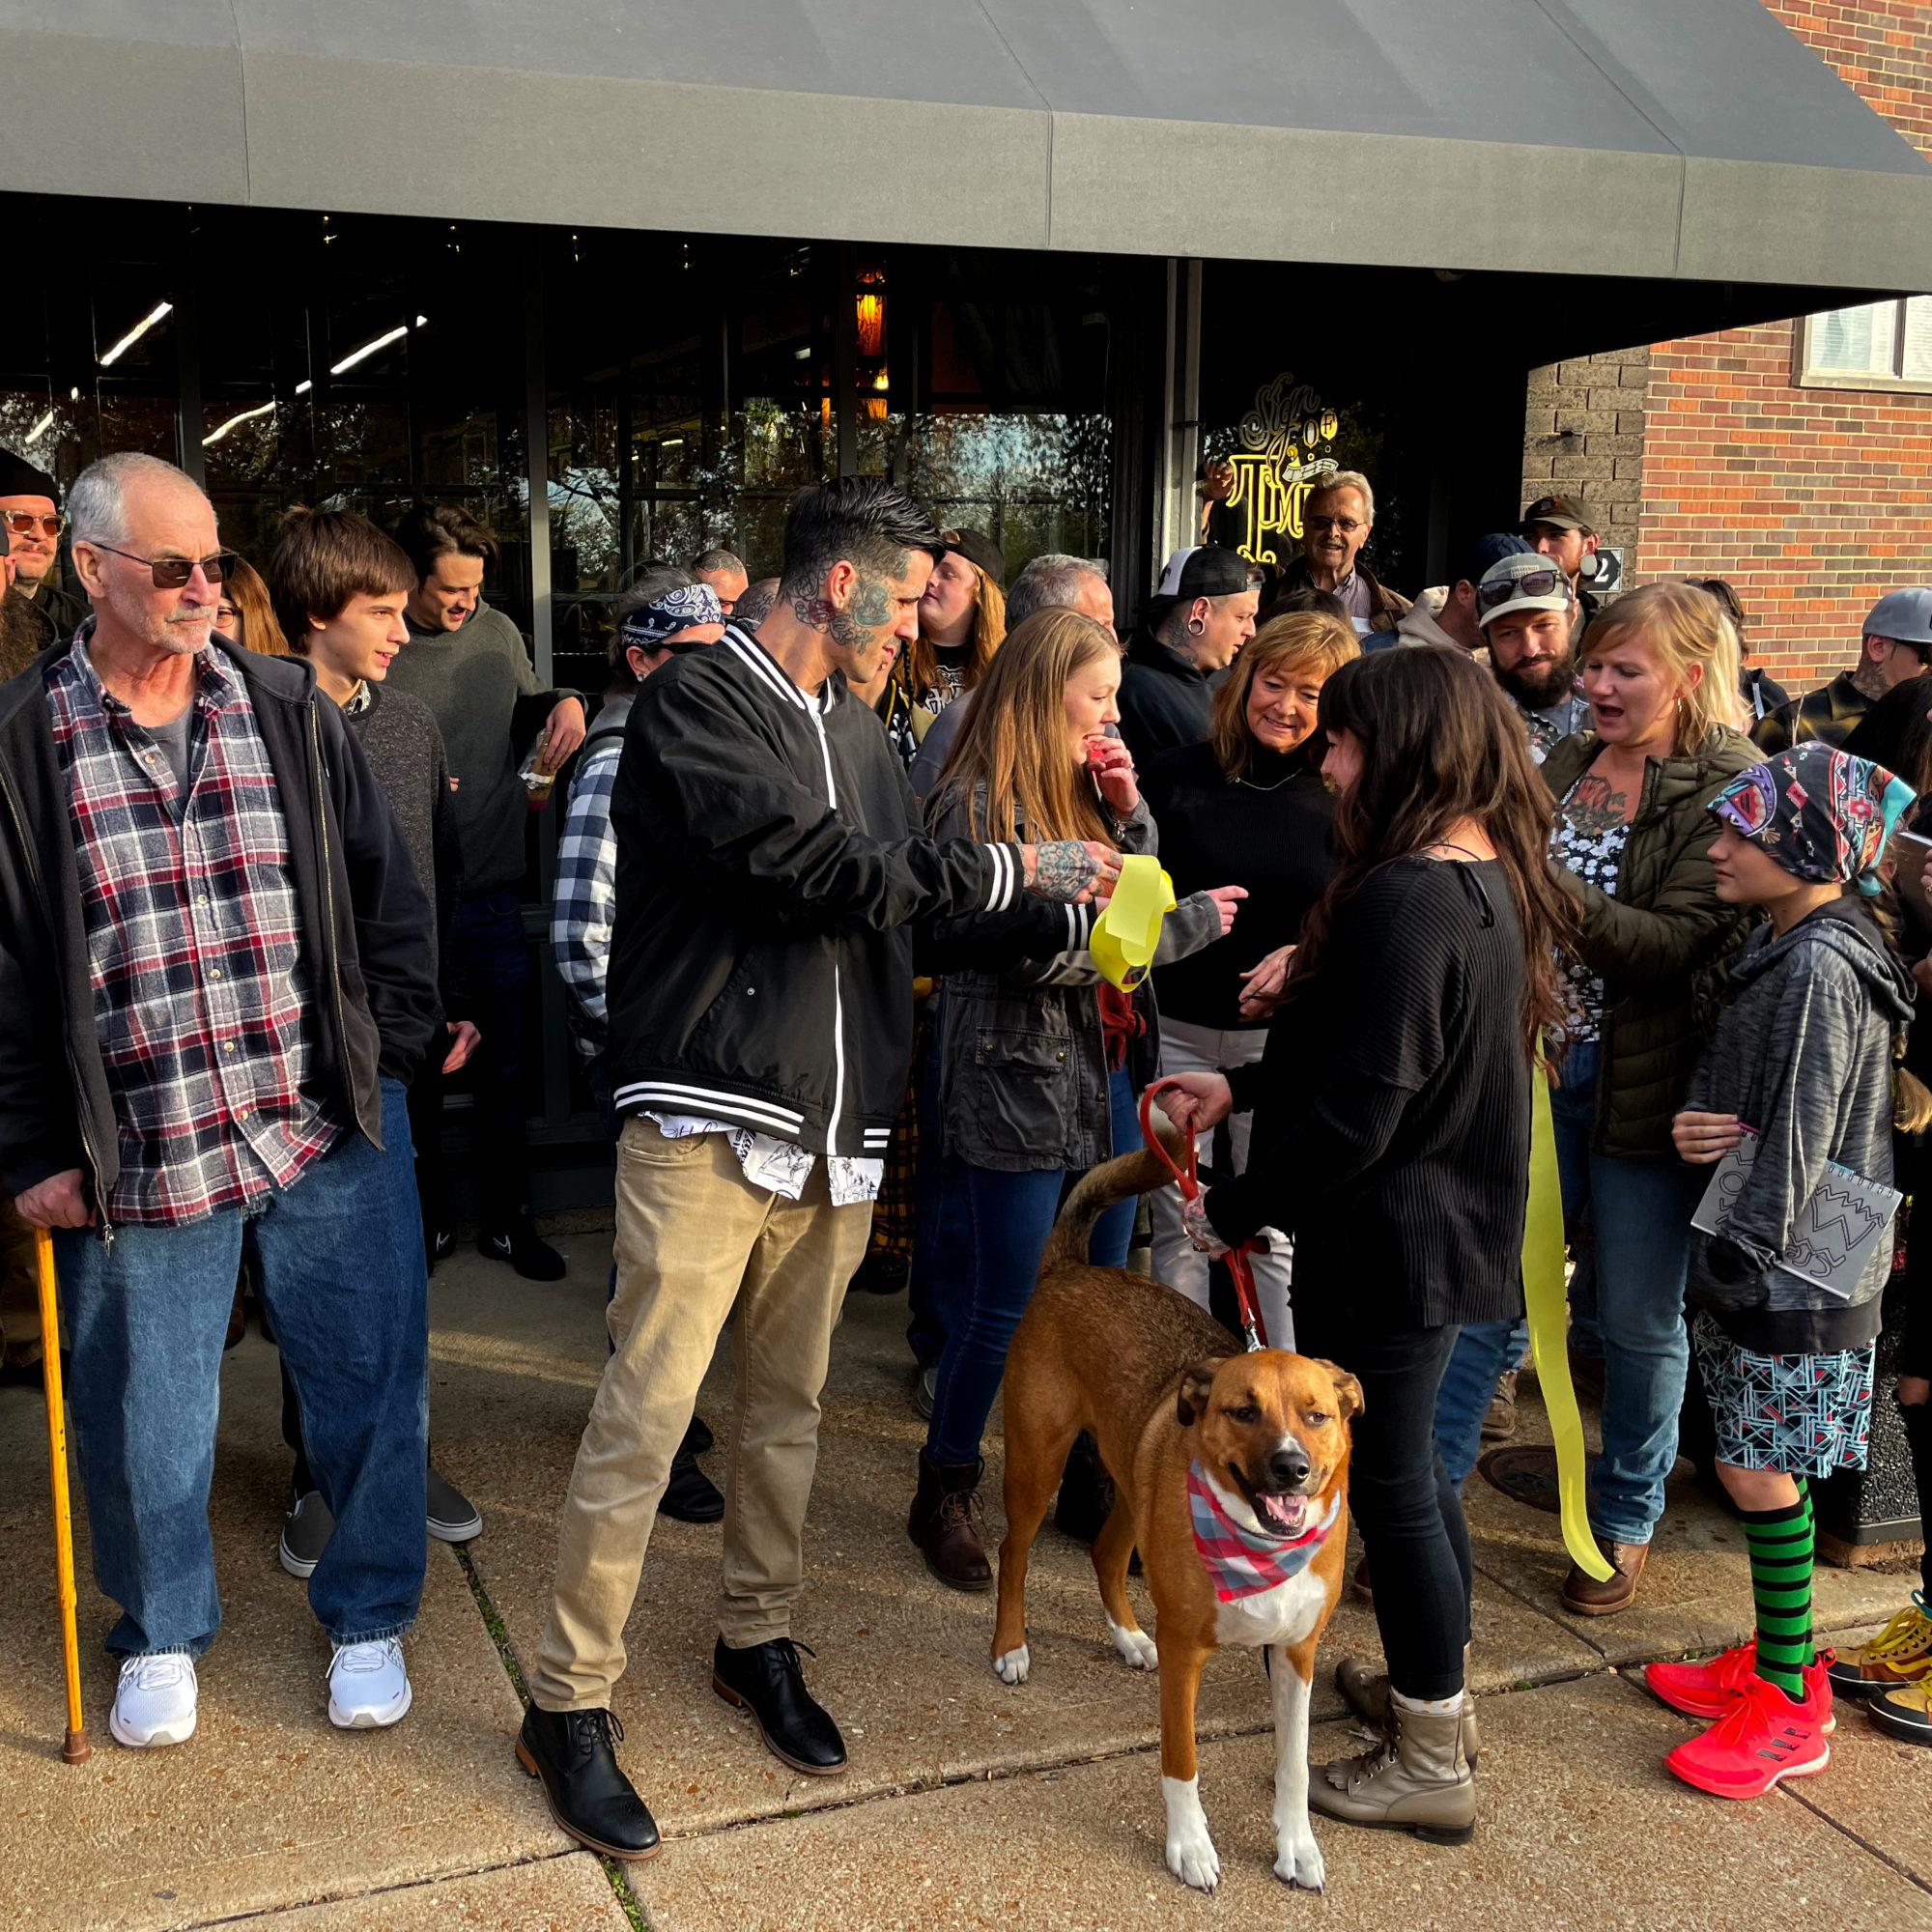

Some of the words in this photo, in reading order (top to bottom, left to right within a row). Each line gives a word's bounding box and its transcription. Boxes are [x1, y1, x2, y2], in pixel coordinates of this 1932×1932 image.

[1238, 371, 1321, 471] Sign
[1303, 411, 1338, 448] OF
[1285, 459, 1338, 481] THE
